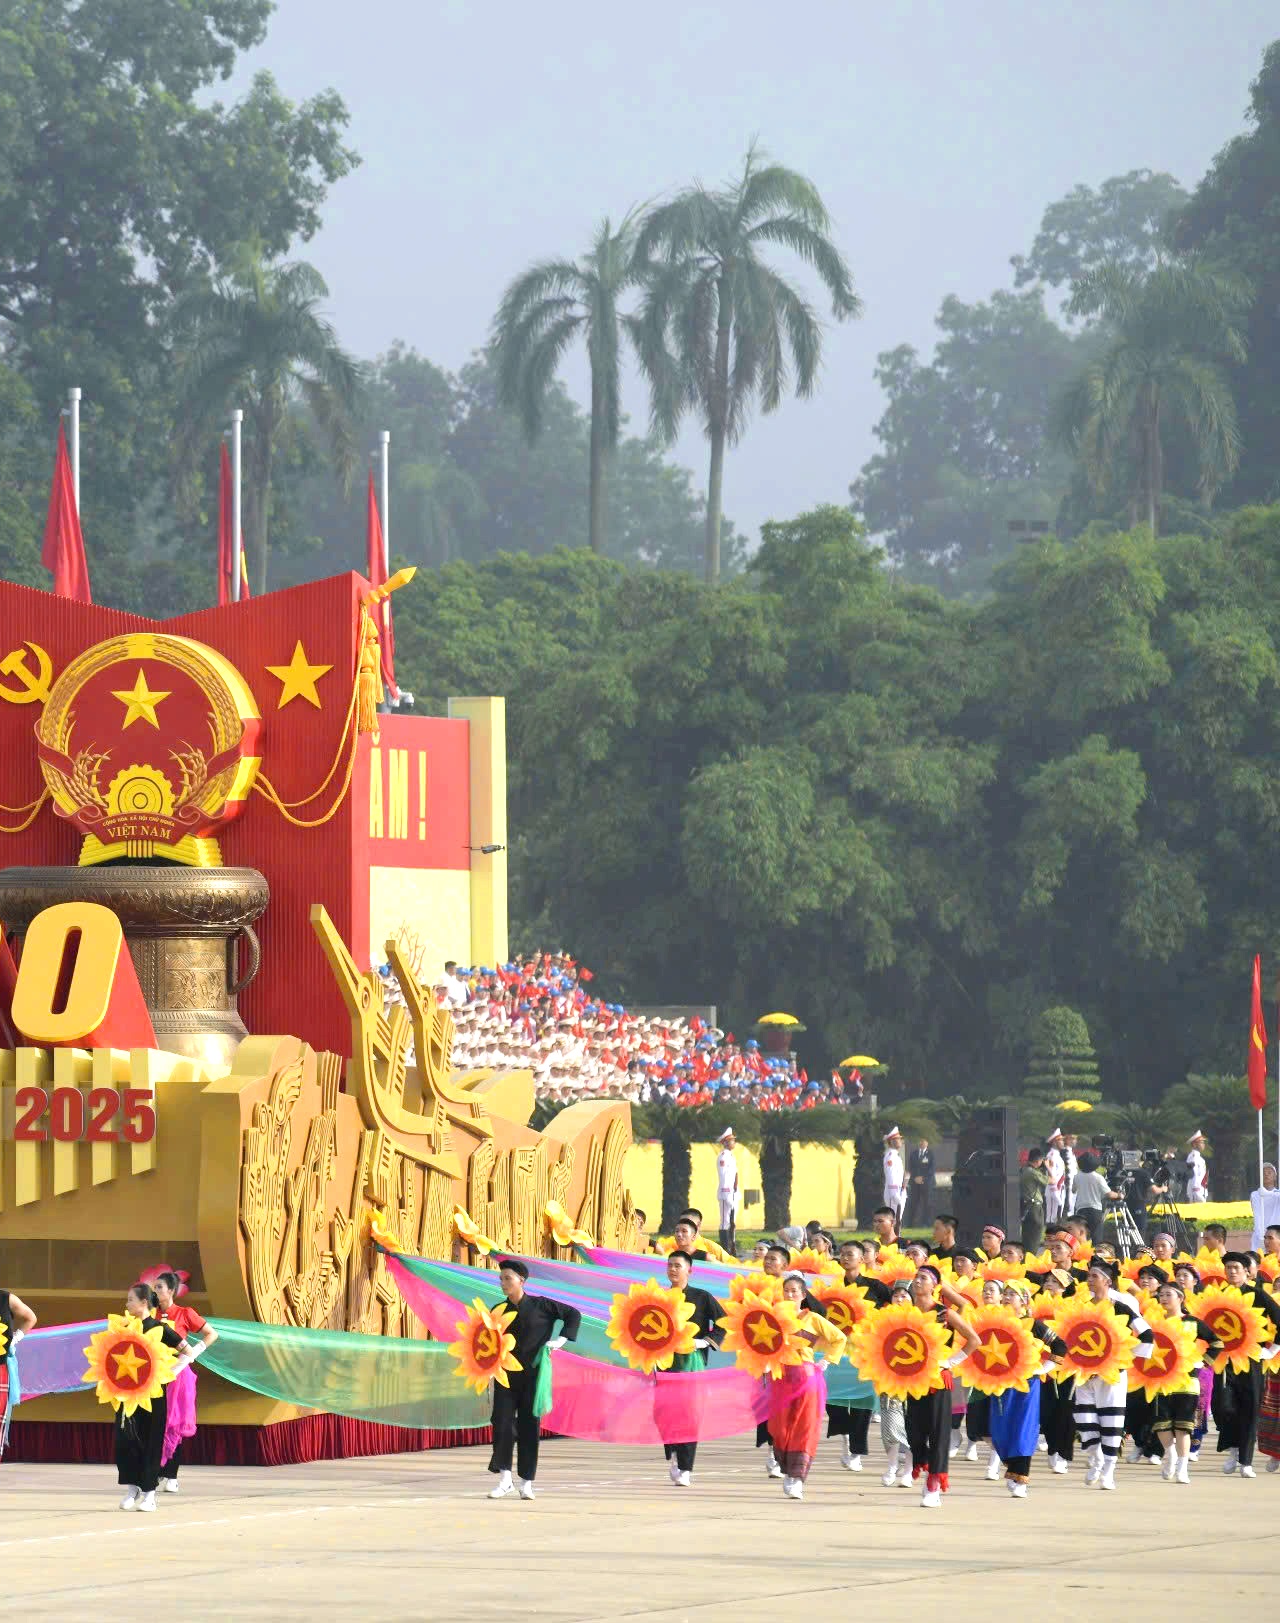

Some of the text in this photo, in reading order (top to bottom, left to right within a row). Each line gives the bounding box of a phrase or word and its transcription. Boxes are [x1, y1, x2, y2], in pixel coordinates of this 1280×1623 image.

[107, 824, 172, 840] VIỆT NAM
[14, 1087, 157, 1143] 2025
